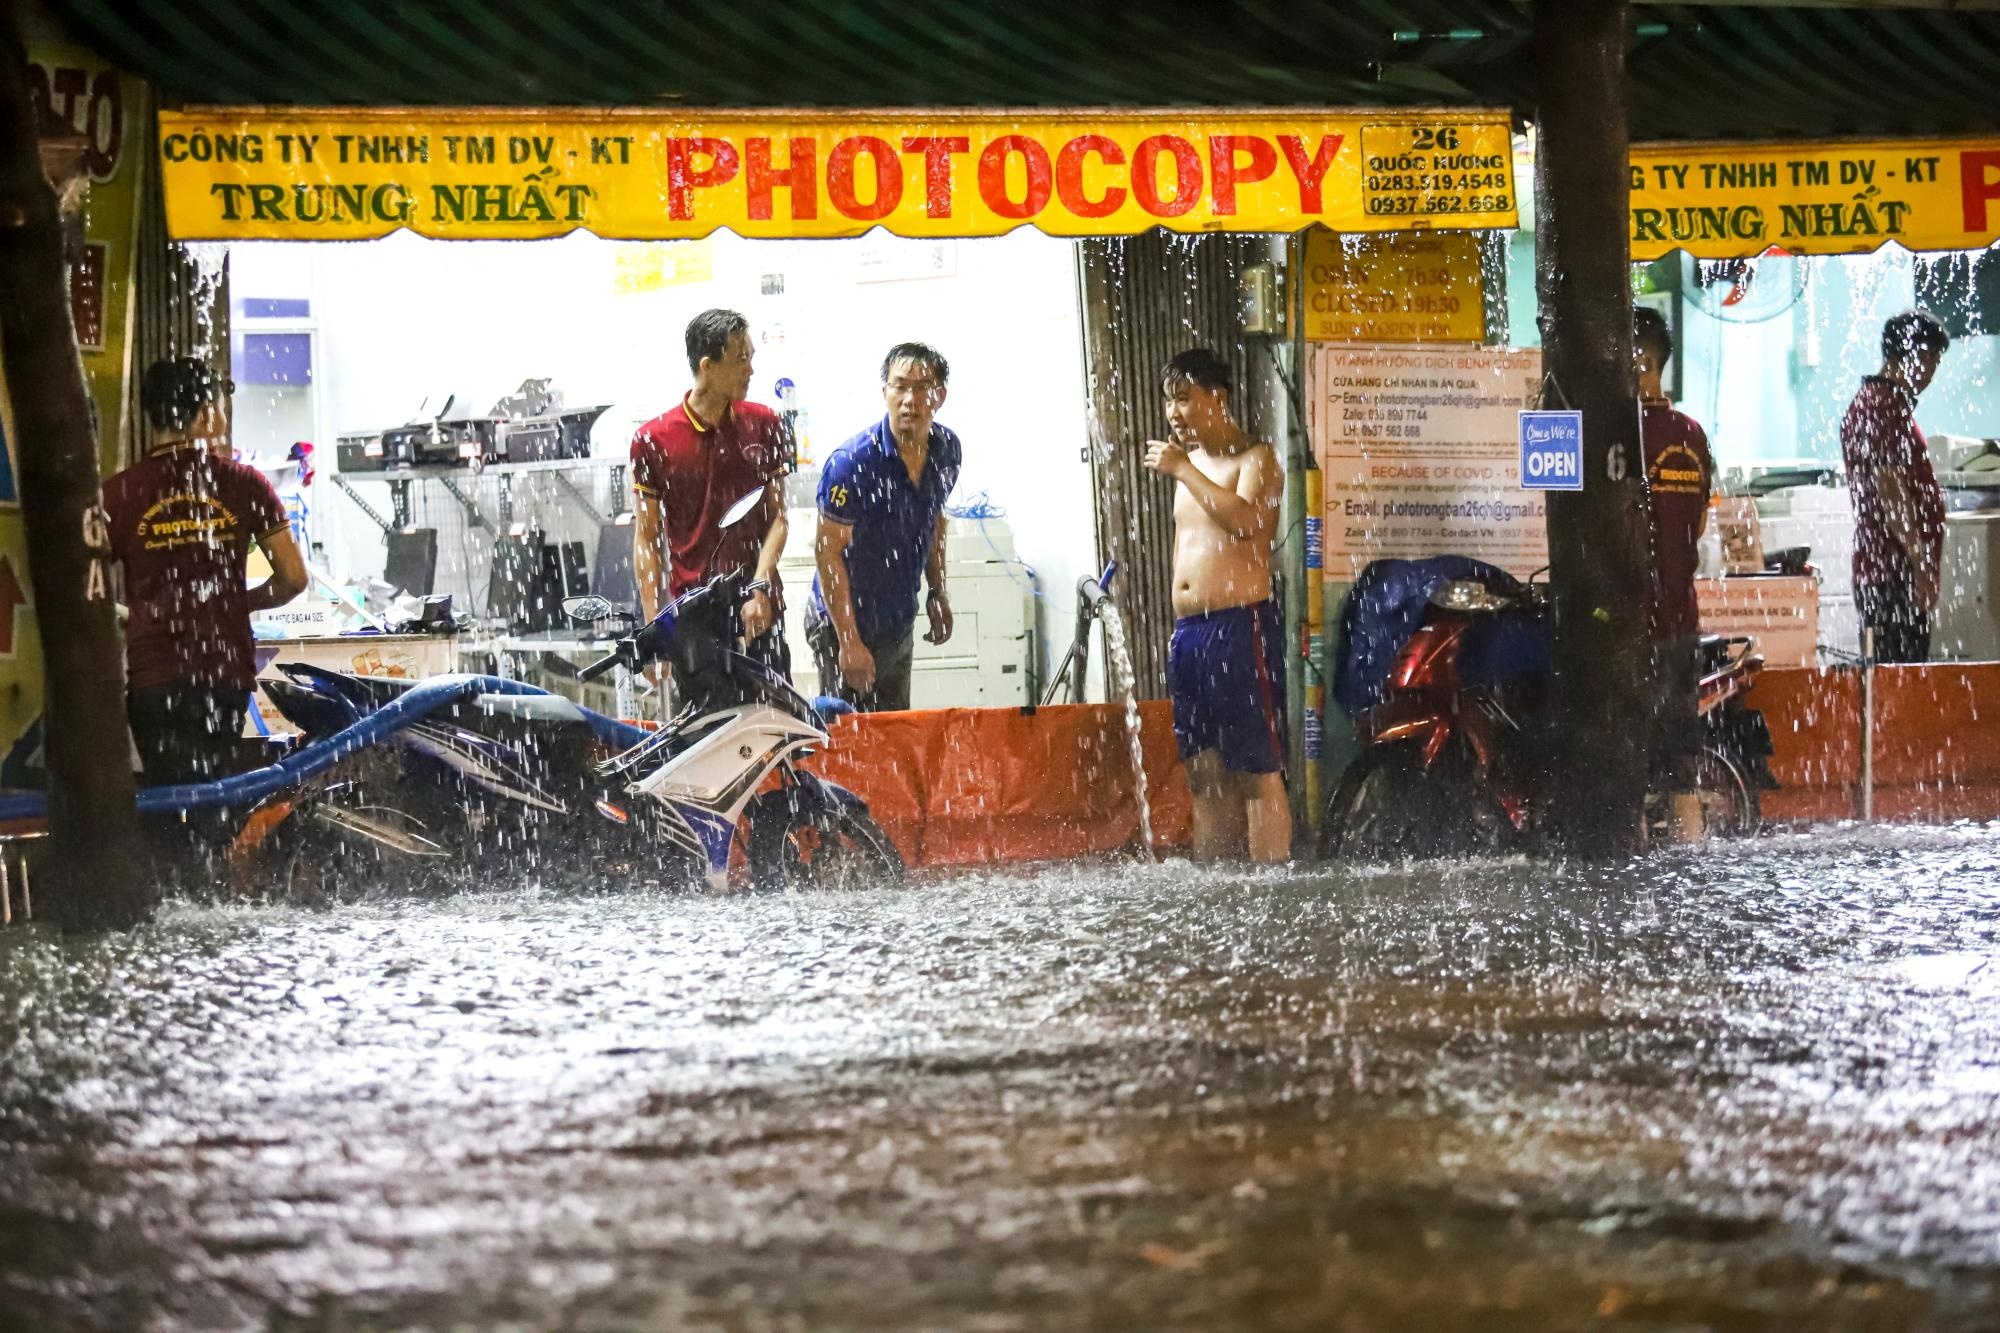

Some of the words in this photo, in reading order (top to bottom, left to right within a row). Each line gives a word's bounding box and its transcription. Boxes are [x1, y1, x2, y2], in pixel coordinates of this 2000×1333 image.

[163, 127, 263, 163] CÔNG
[275, 135, 319, 163] TY
[333, 135, 428, 163] TNHH
[443, 136, 495, 164] TM
[510, 136, 554, 164] DV
[591, 137, 634, 164] KT
[1412, 127, 1461, 151] 26
[1370, 151, 1426, 171] QUỐC
[1434, 153, 1504, 171] HƯƠNG
[666, 134, 1345, 220] PHOTOCOPY
[1369, 173, 1506, 191] 0283.519.4548
[1652, 165, 1689, 189] TY
[1700, 162, 1777, 189] TNHH
[1787, 160, 1829, 186] TM
[1840, 159, 1876, 185] DV
[1905, 157, 1940, 182] KT
[210, 182, 413, 223] TRUNG
[431, 165, 594, 222] NHẤT
[1371, 195, 1509, 213] 0937.562.668
[1631, 204, 1767, 241] RUNG
[1779, 186, 1907, 237] NHẤT
[1378, 322, 1417, 336] OPEN
[1406, 409, 1427, 421] 7744
[1528, 452, 1576, 477] OPEN
[1607, 443, 1626, 481] 6
[1371, 466, 1430, 479] BECAUSE
[1434, 466, 1450, 479] OF
[1454, 466, 1493, 480] COVID
[1504, 466, 1518, 479] 19
[831, 485, 848, 506] 15
[1345, 501, 1380, 517] Email:
[152, 517, 227, 536] PHOTOCOPY
